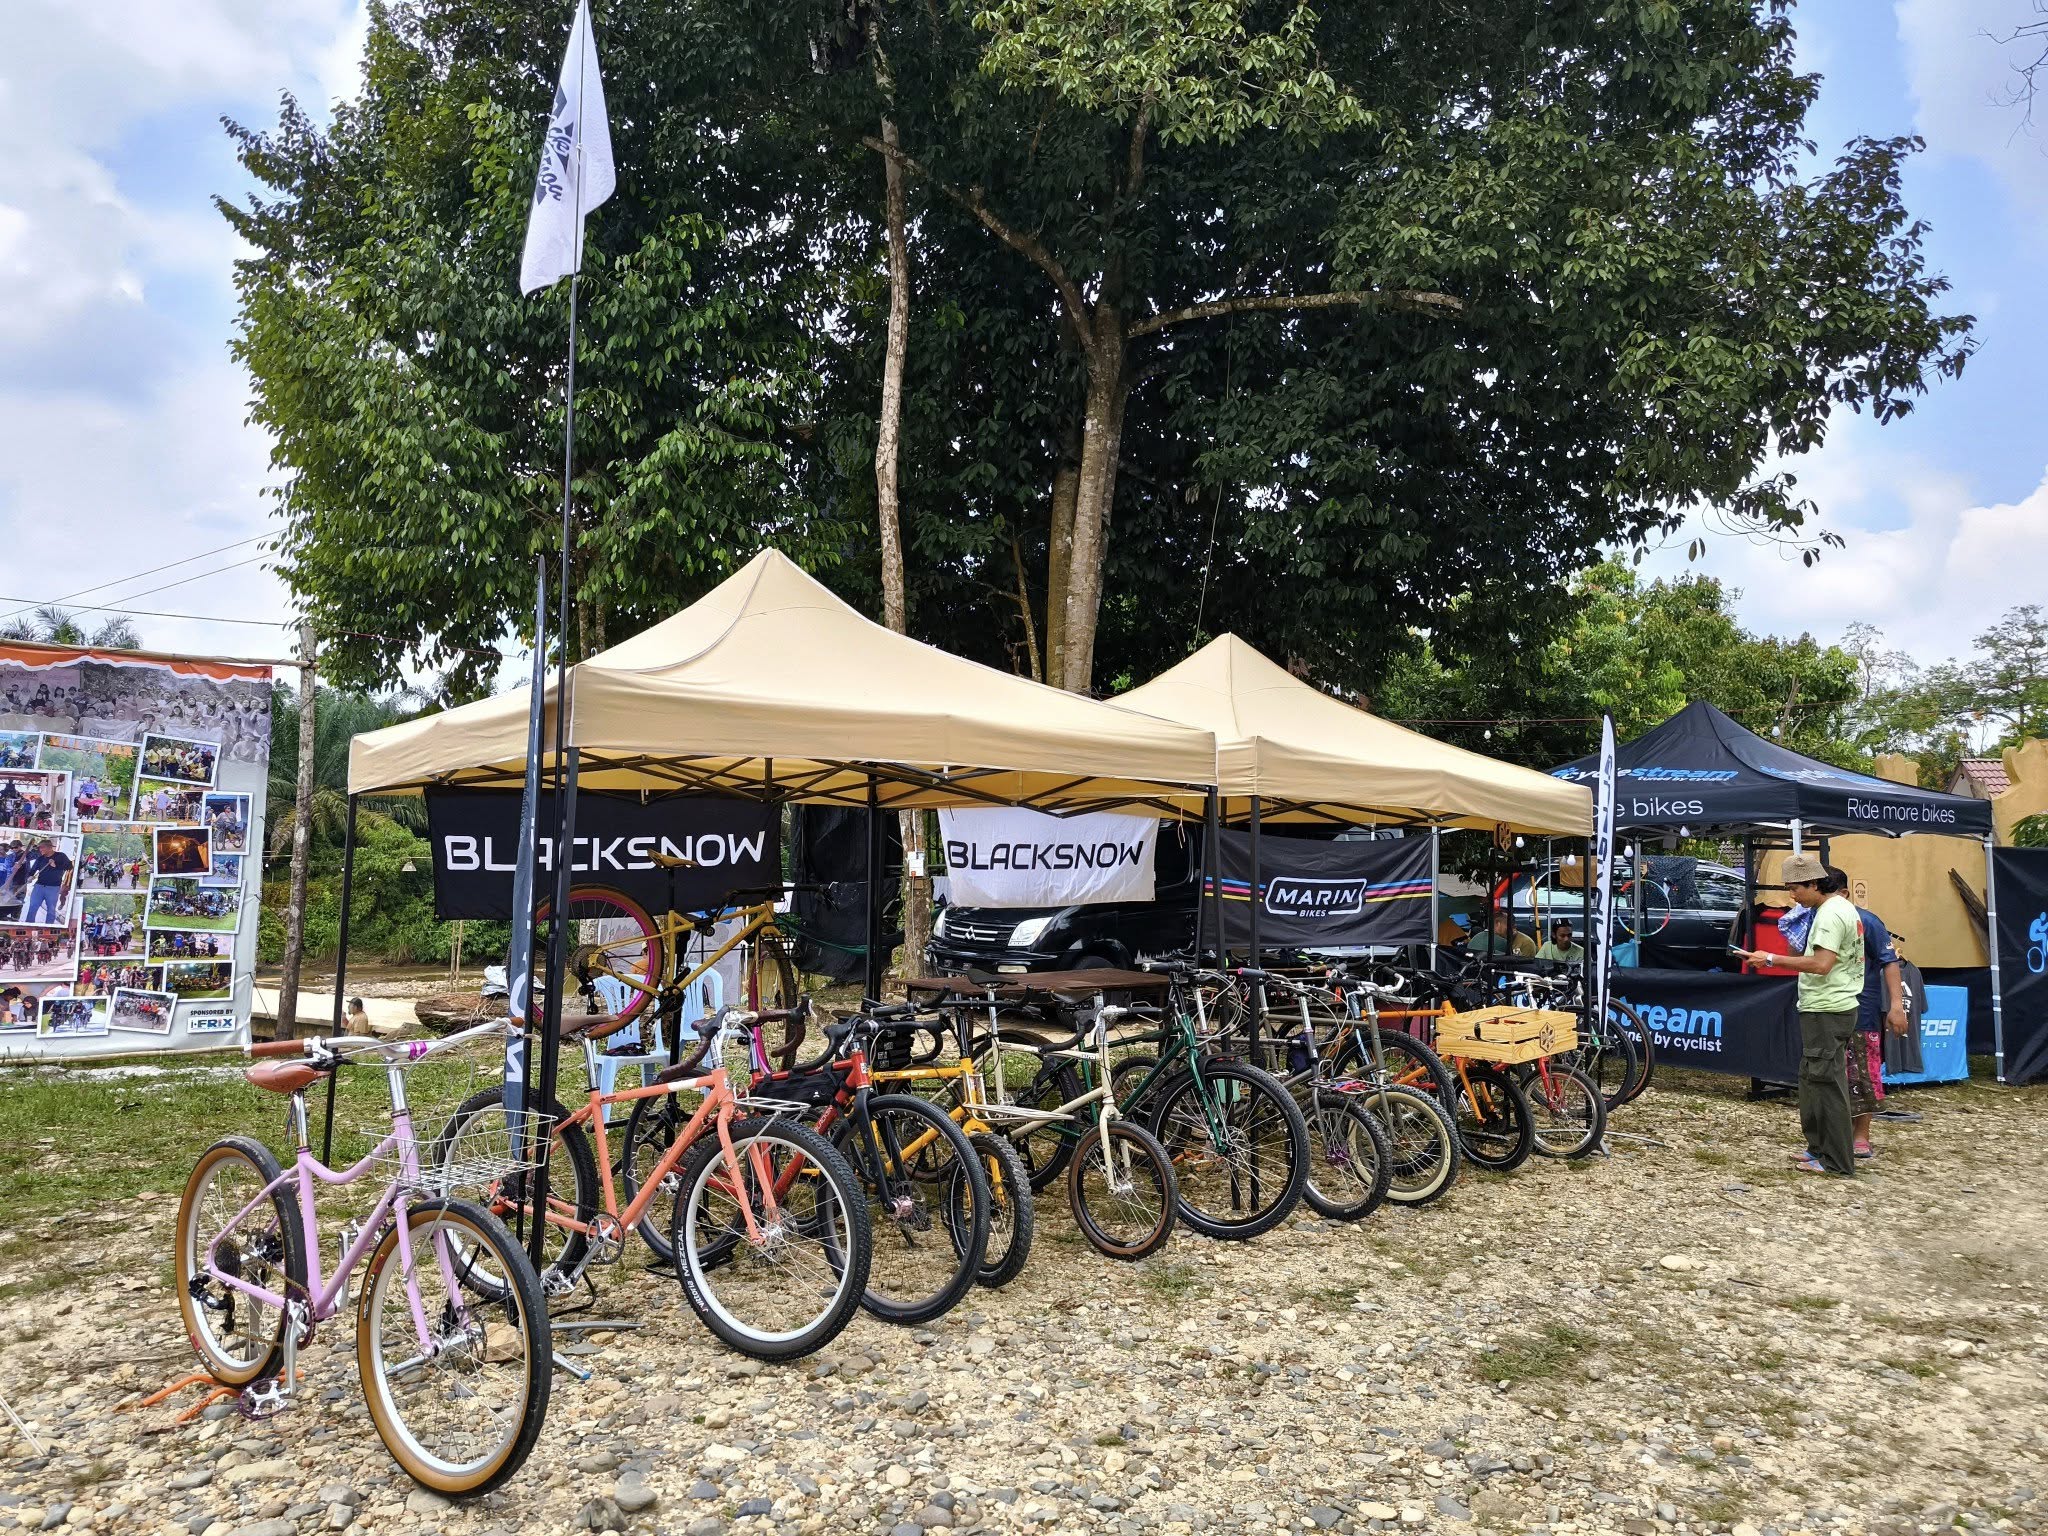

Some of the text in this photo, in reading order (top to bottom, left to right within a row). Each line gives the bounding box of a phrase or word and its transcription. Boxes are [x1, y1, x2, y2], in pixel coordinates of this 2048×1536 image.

[1632, 797, 1704, 817] bikes
[1847, 798, 1956, 824] Ride more bikes
[947, 840, 1144, 870] BLACKSNOW
[1275, 888, 1358, 905] MARIN
[1299, 909, 1327, 917] BIKES
[1654, 1032, 1671, 1049] by
[1674, 1035, 1722, 1052] cyclist
[677, 1226, 691, 1277] MEZCAL
